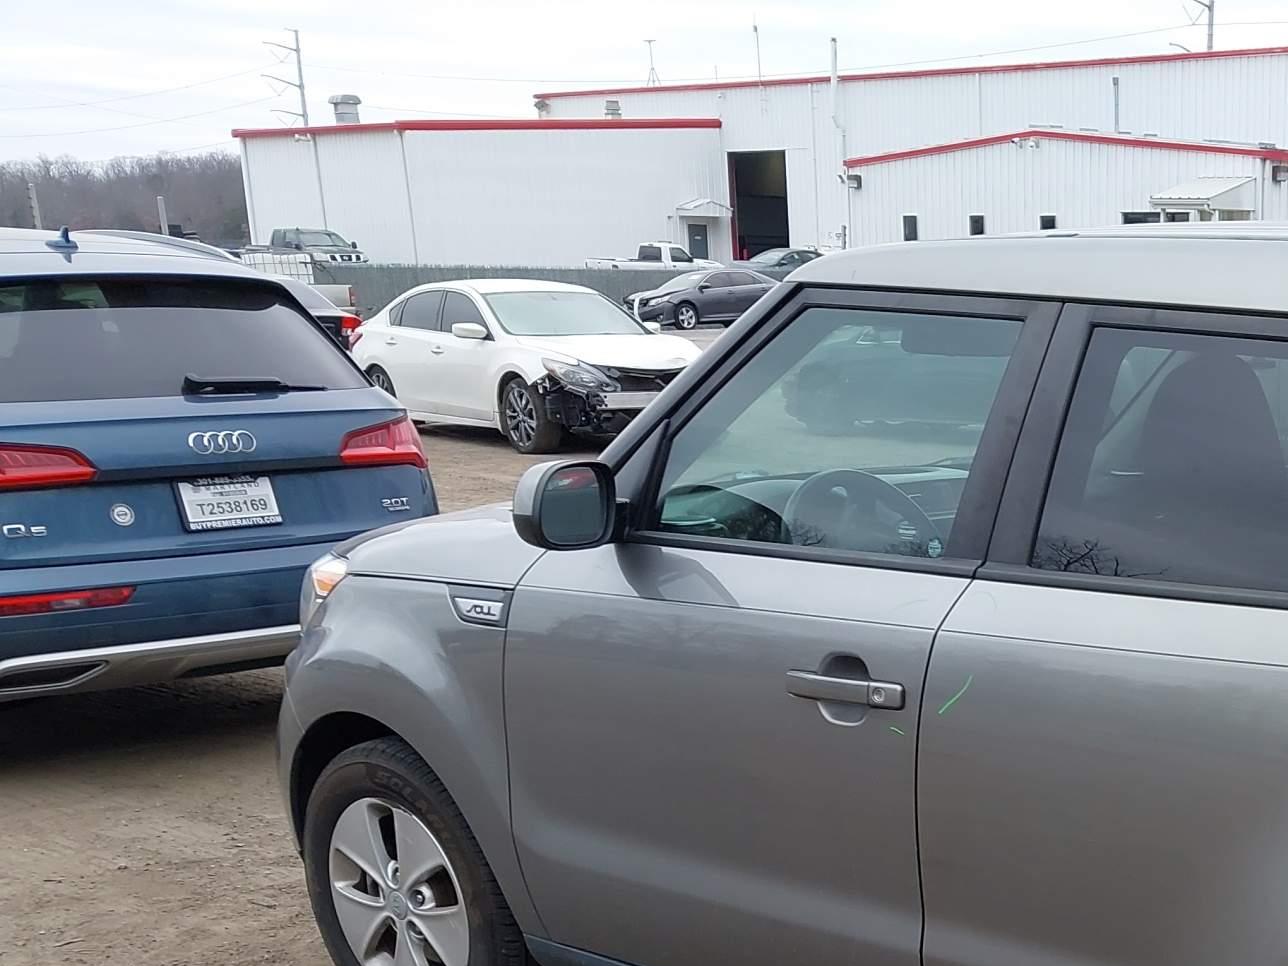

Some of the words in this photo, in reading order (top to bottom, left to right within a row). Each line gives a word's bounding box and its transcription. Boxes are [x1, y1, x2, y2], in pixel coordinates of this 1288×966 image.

[196, 498, 267, 516] T2538169
[190, 516, 283, 530] BUYPREMIERAUTO.COM
[2, 524, 48, 538] Q5
